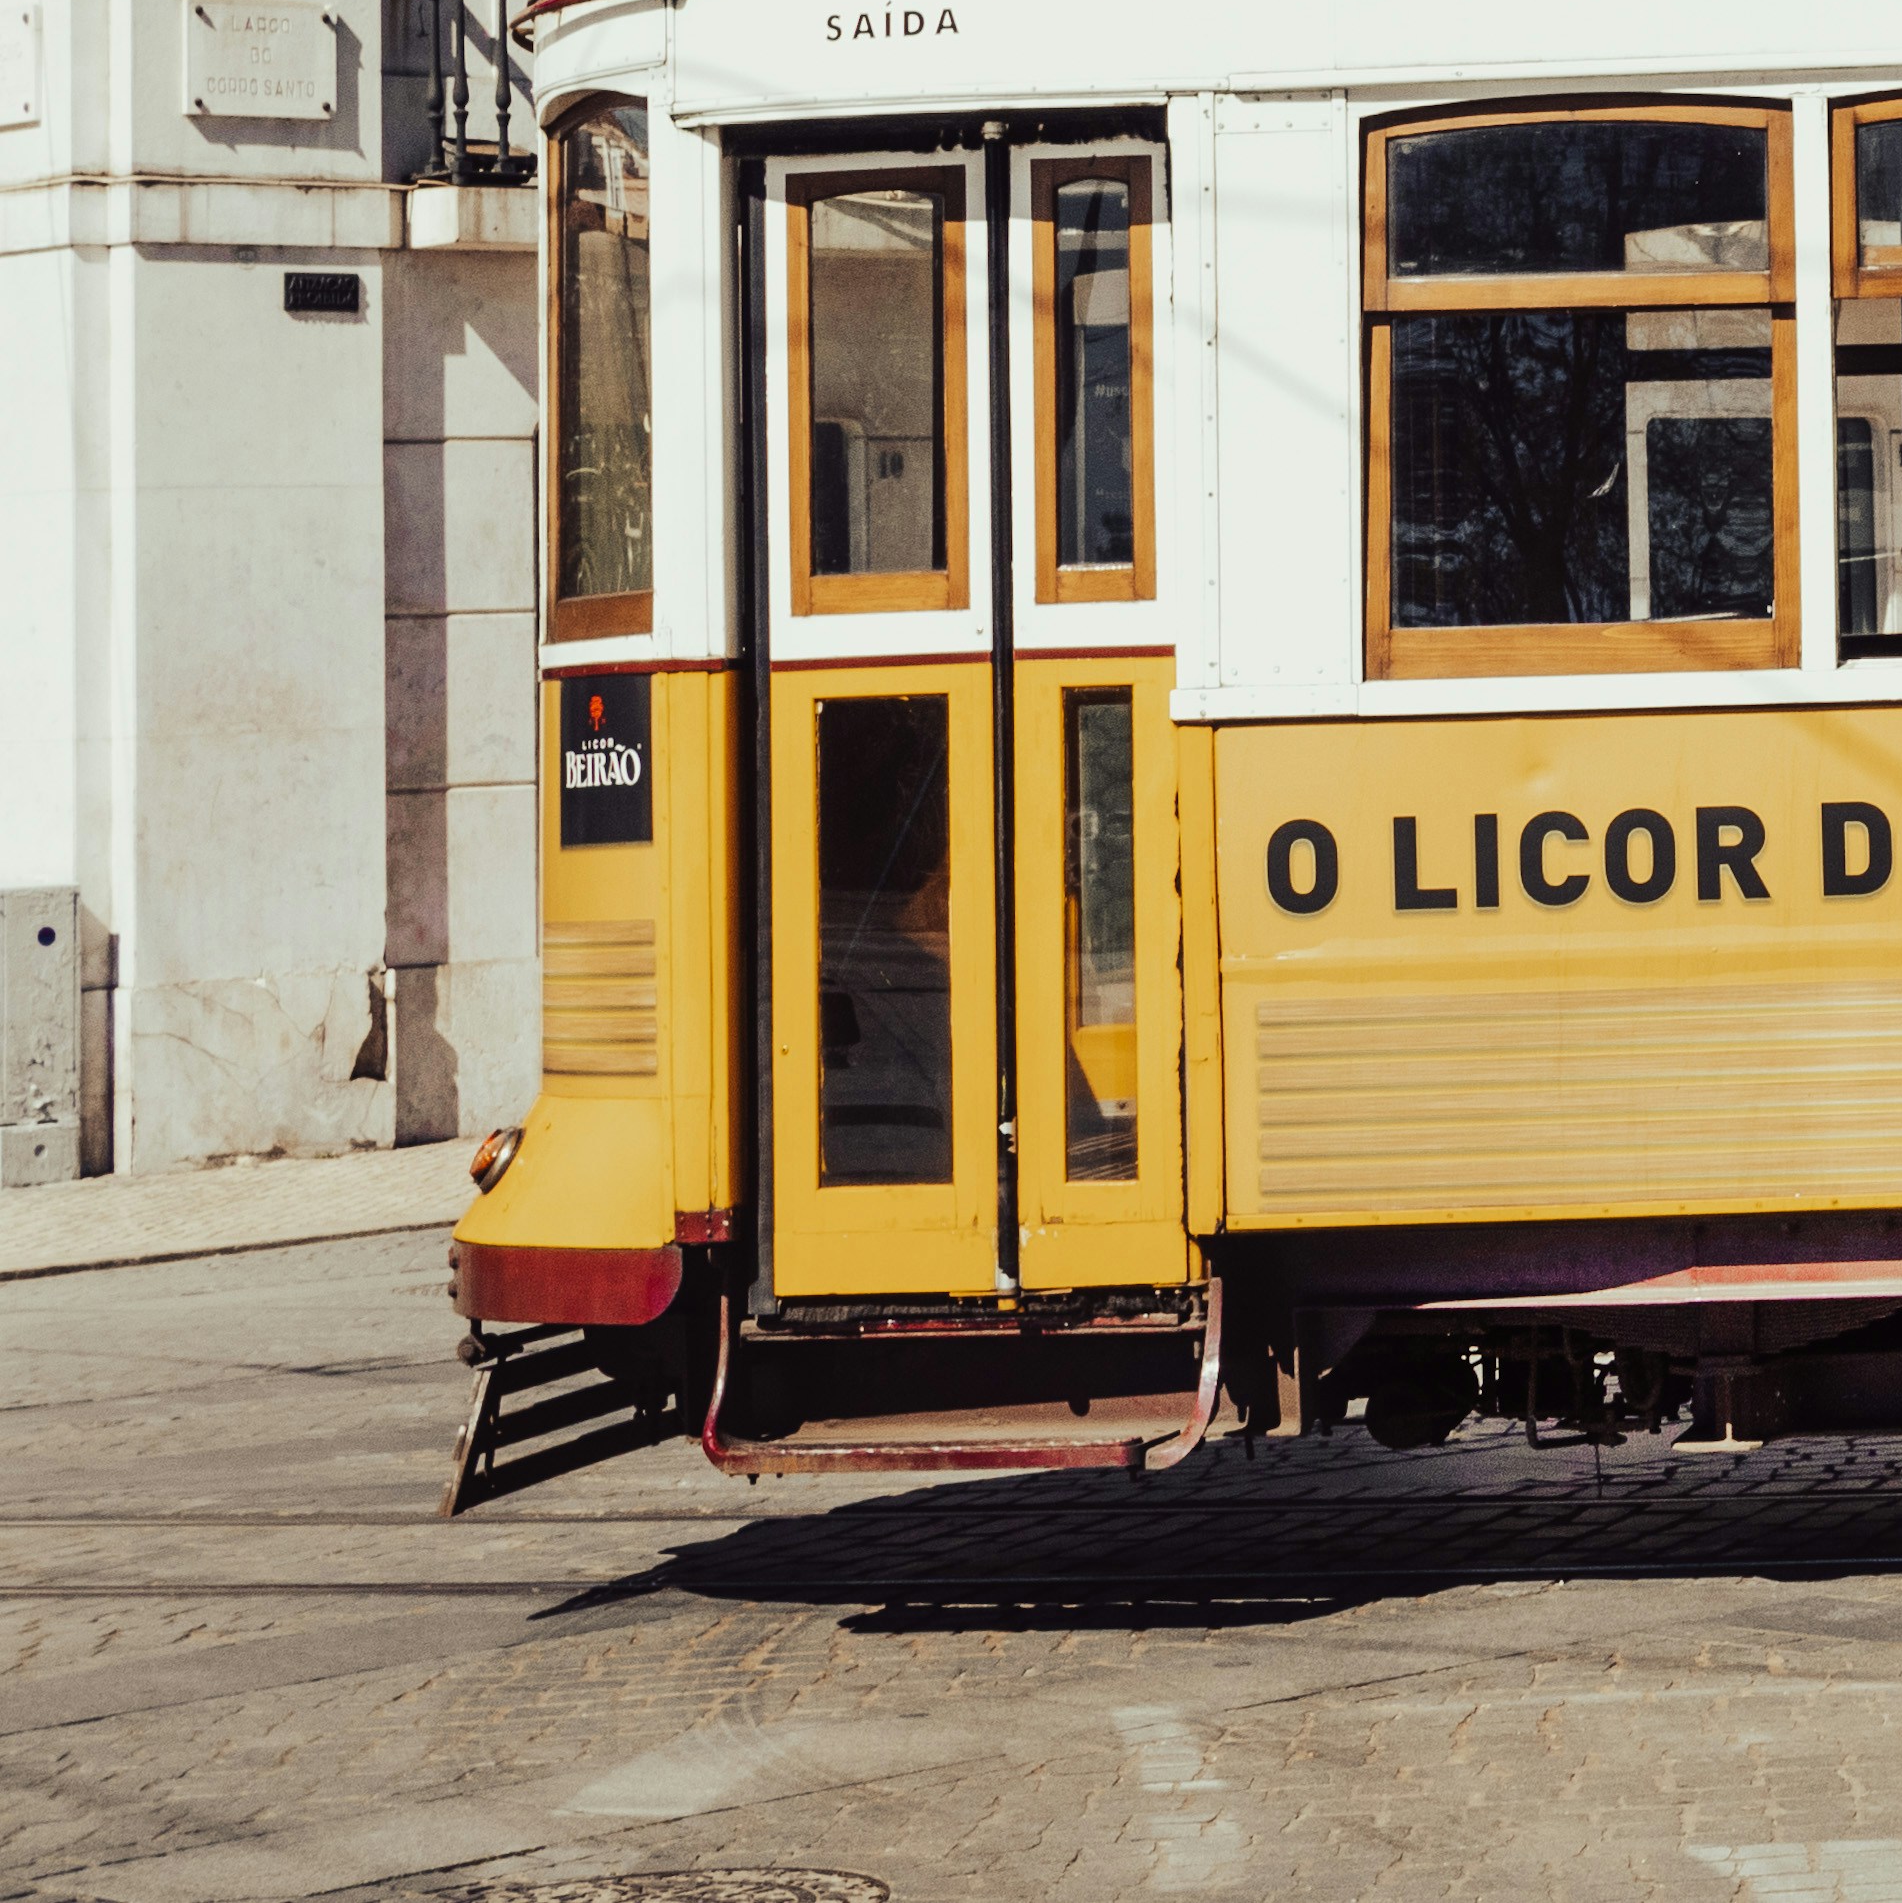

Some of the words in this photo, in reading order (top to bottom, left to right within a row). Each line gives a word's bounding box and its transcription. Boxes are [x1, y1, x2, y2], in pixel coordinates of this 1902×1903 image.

[826, 0, 959, 41] SAÍDA
[264, 78, 315, 98] SANTO
[582, 738, 615, 751] LICOR
[566, 743, 642, 789] BEIRÃO
[1266, 819, 1339, 915] O
[1392, 805, 1772, 911] LICOR
